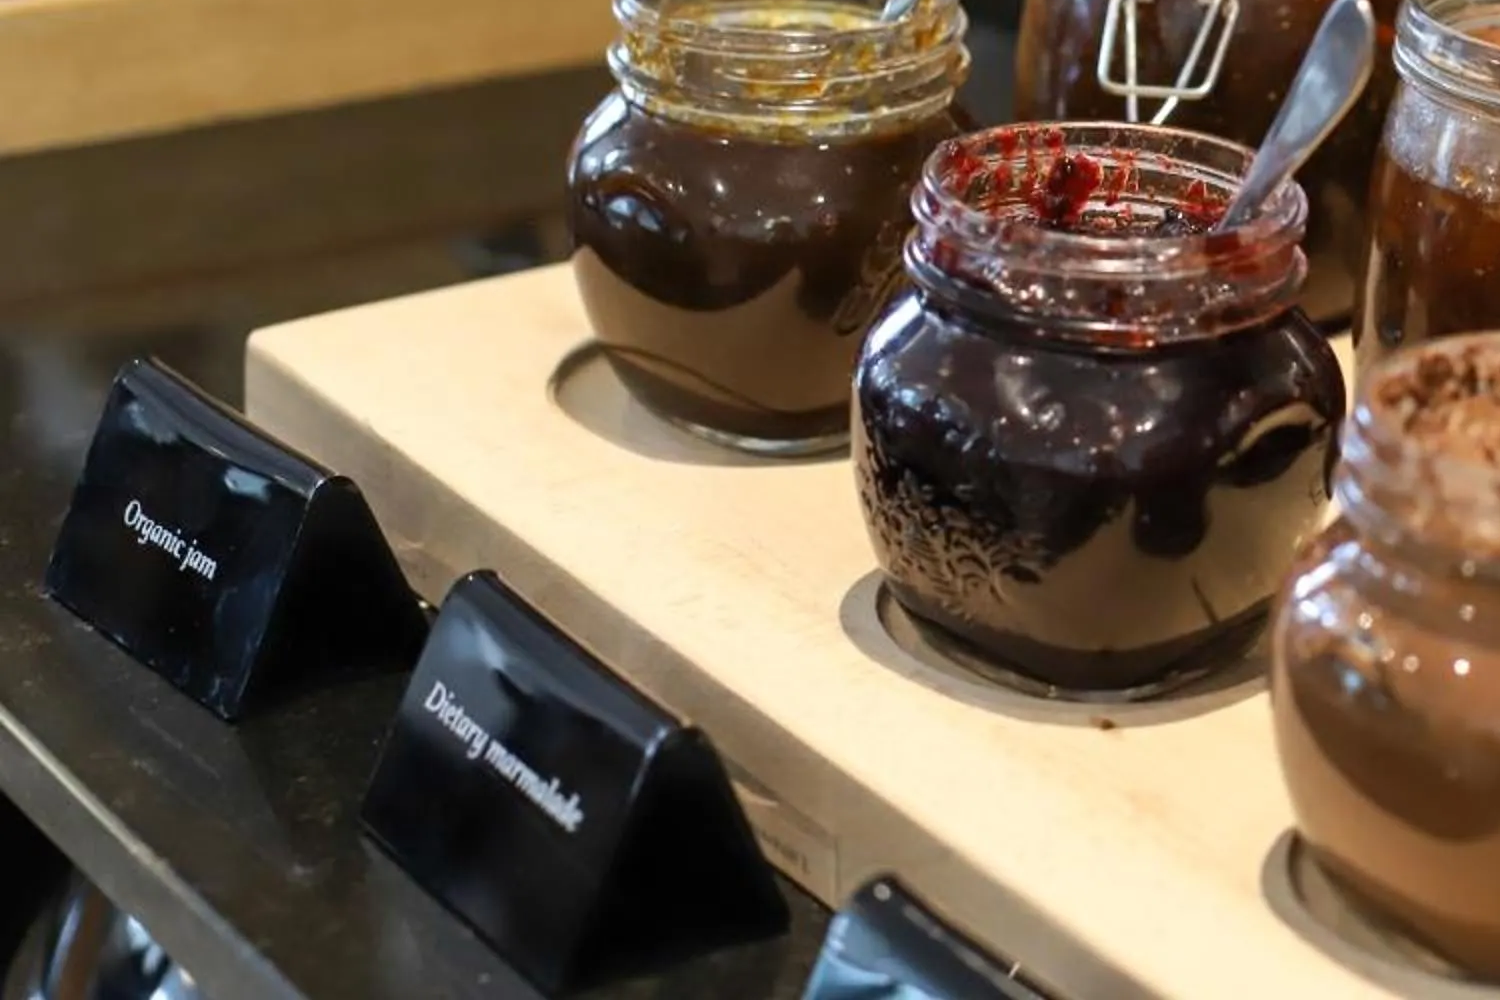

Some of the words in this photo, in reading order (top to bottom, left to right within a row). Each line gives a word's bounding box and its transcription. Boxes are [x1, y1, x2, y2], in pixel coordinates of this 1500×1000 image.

[123, 499, 186, 559] Organic
[179, 539, 217, 580] jam
[424, 680, 490, 760] Dietary
[484, 738, 584, 833] marmalade
